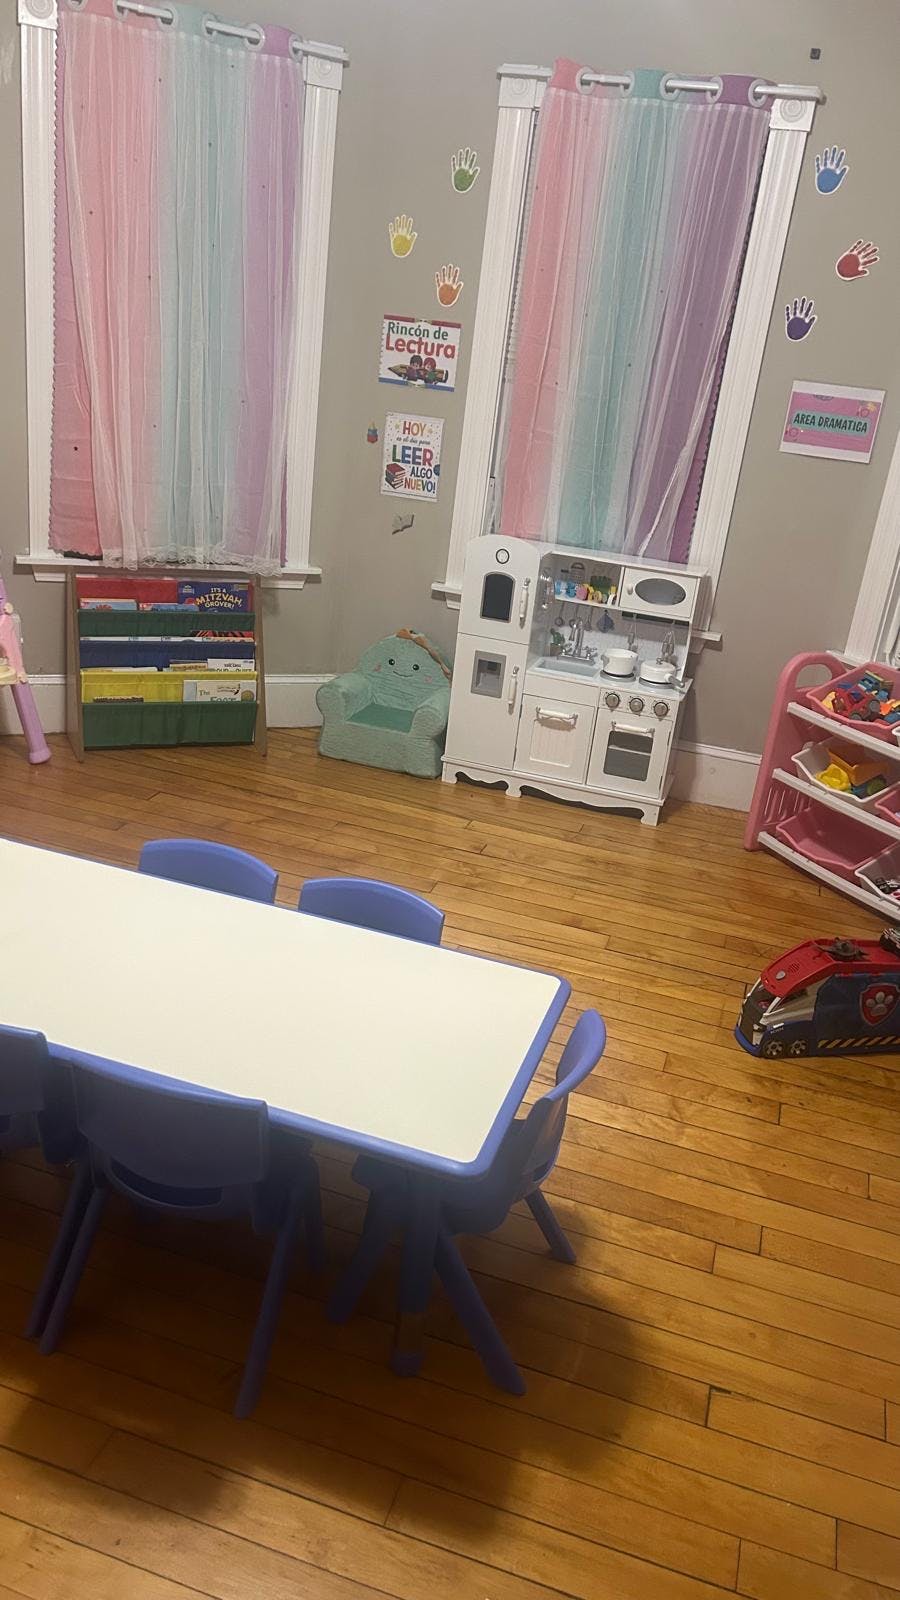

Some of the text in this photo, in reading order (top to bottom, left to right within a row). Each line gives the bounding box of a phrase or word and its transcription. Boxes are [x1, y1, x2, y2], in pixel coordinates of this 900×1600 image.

[388, 321, 449, 340] Rincón de
[385, 333, 456, 359] Lectura
[793, 413, 816, 426] AREA
[402, 421, 427, 436] HOY
[392, 444, 433, 467] LEER
[410, 466, 433, 480] ALGO
[404, 478, 436, 494] NUEVO!
[205, 601, 234, 609] GROVER!
